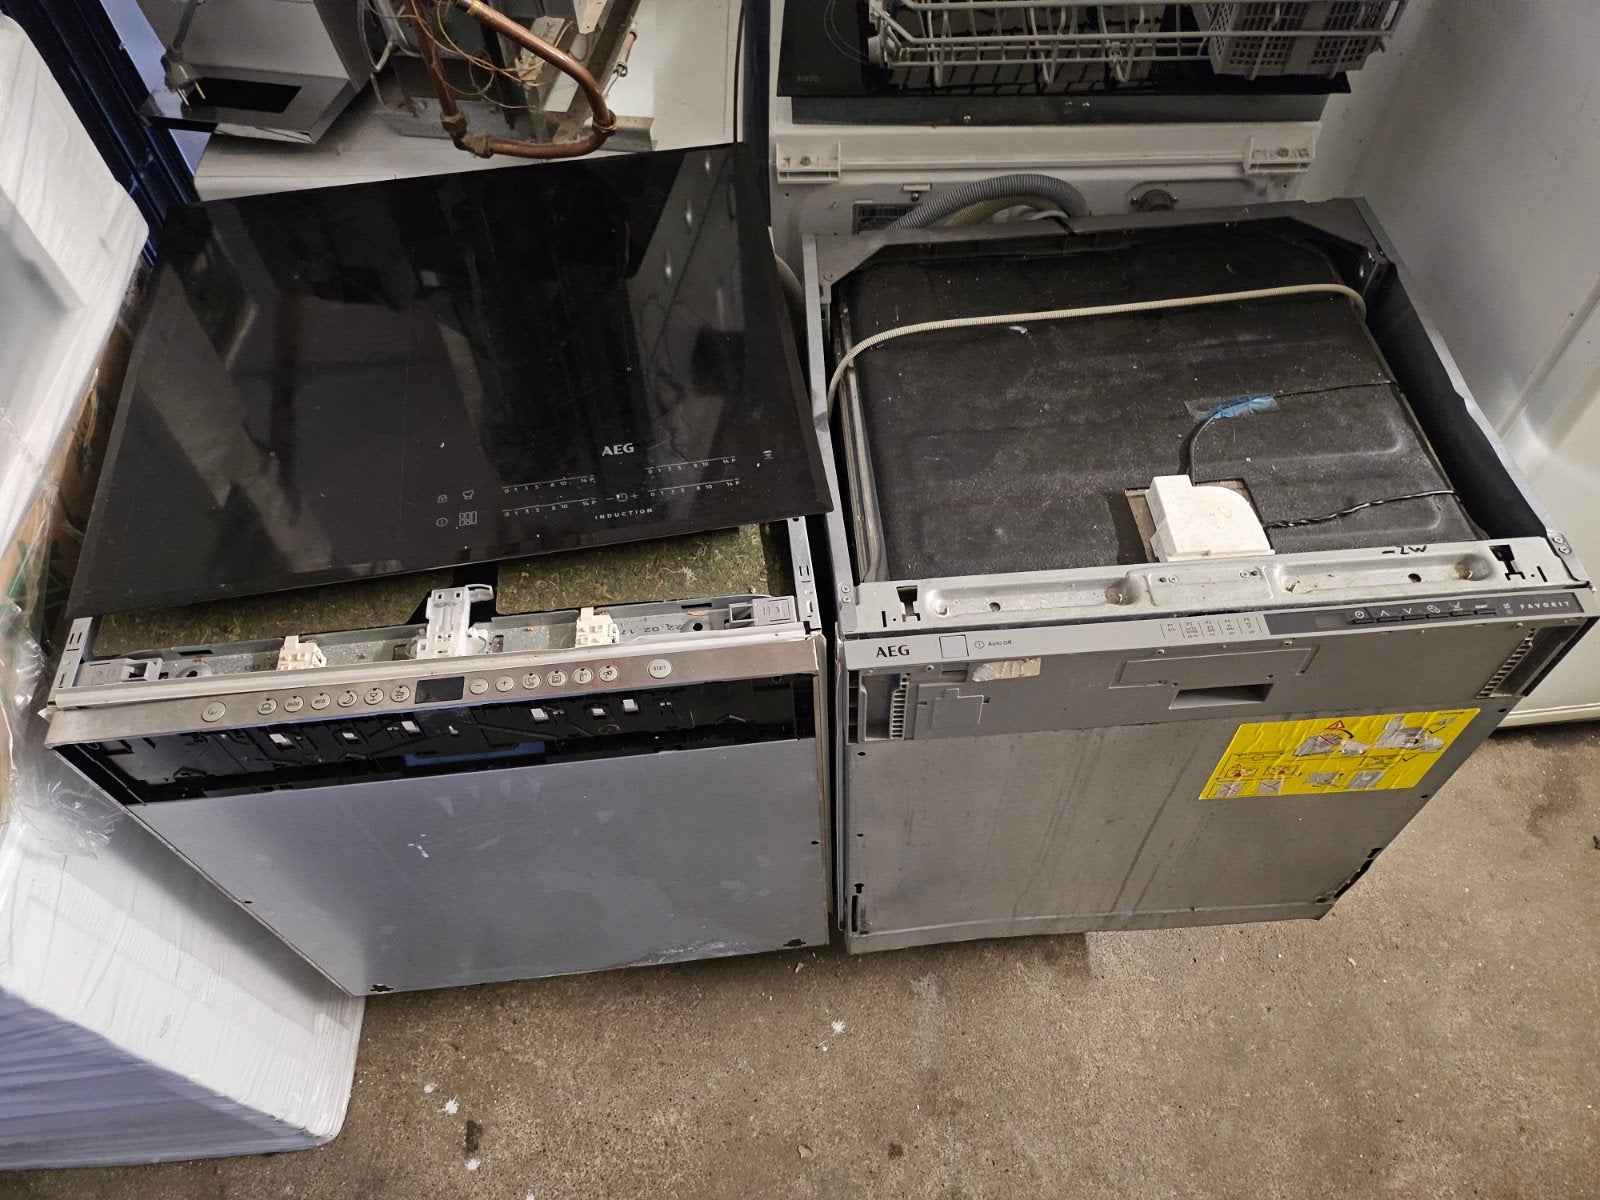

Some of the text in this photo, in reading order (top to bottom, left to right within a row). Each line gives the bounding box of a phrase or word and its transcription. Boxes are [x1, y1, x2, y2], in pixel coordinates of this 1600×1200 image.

[602, 443, 635, 457] AEG
[594, 508, 653, 520] INDUCTION
[1520, 601, 1570, 610] FAVORIT
[876, 644, 910, 658] AEG
[652, 664, 667, 672] start
